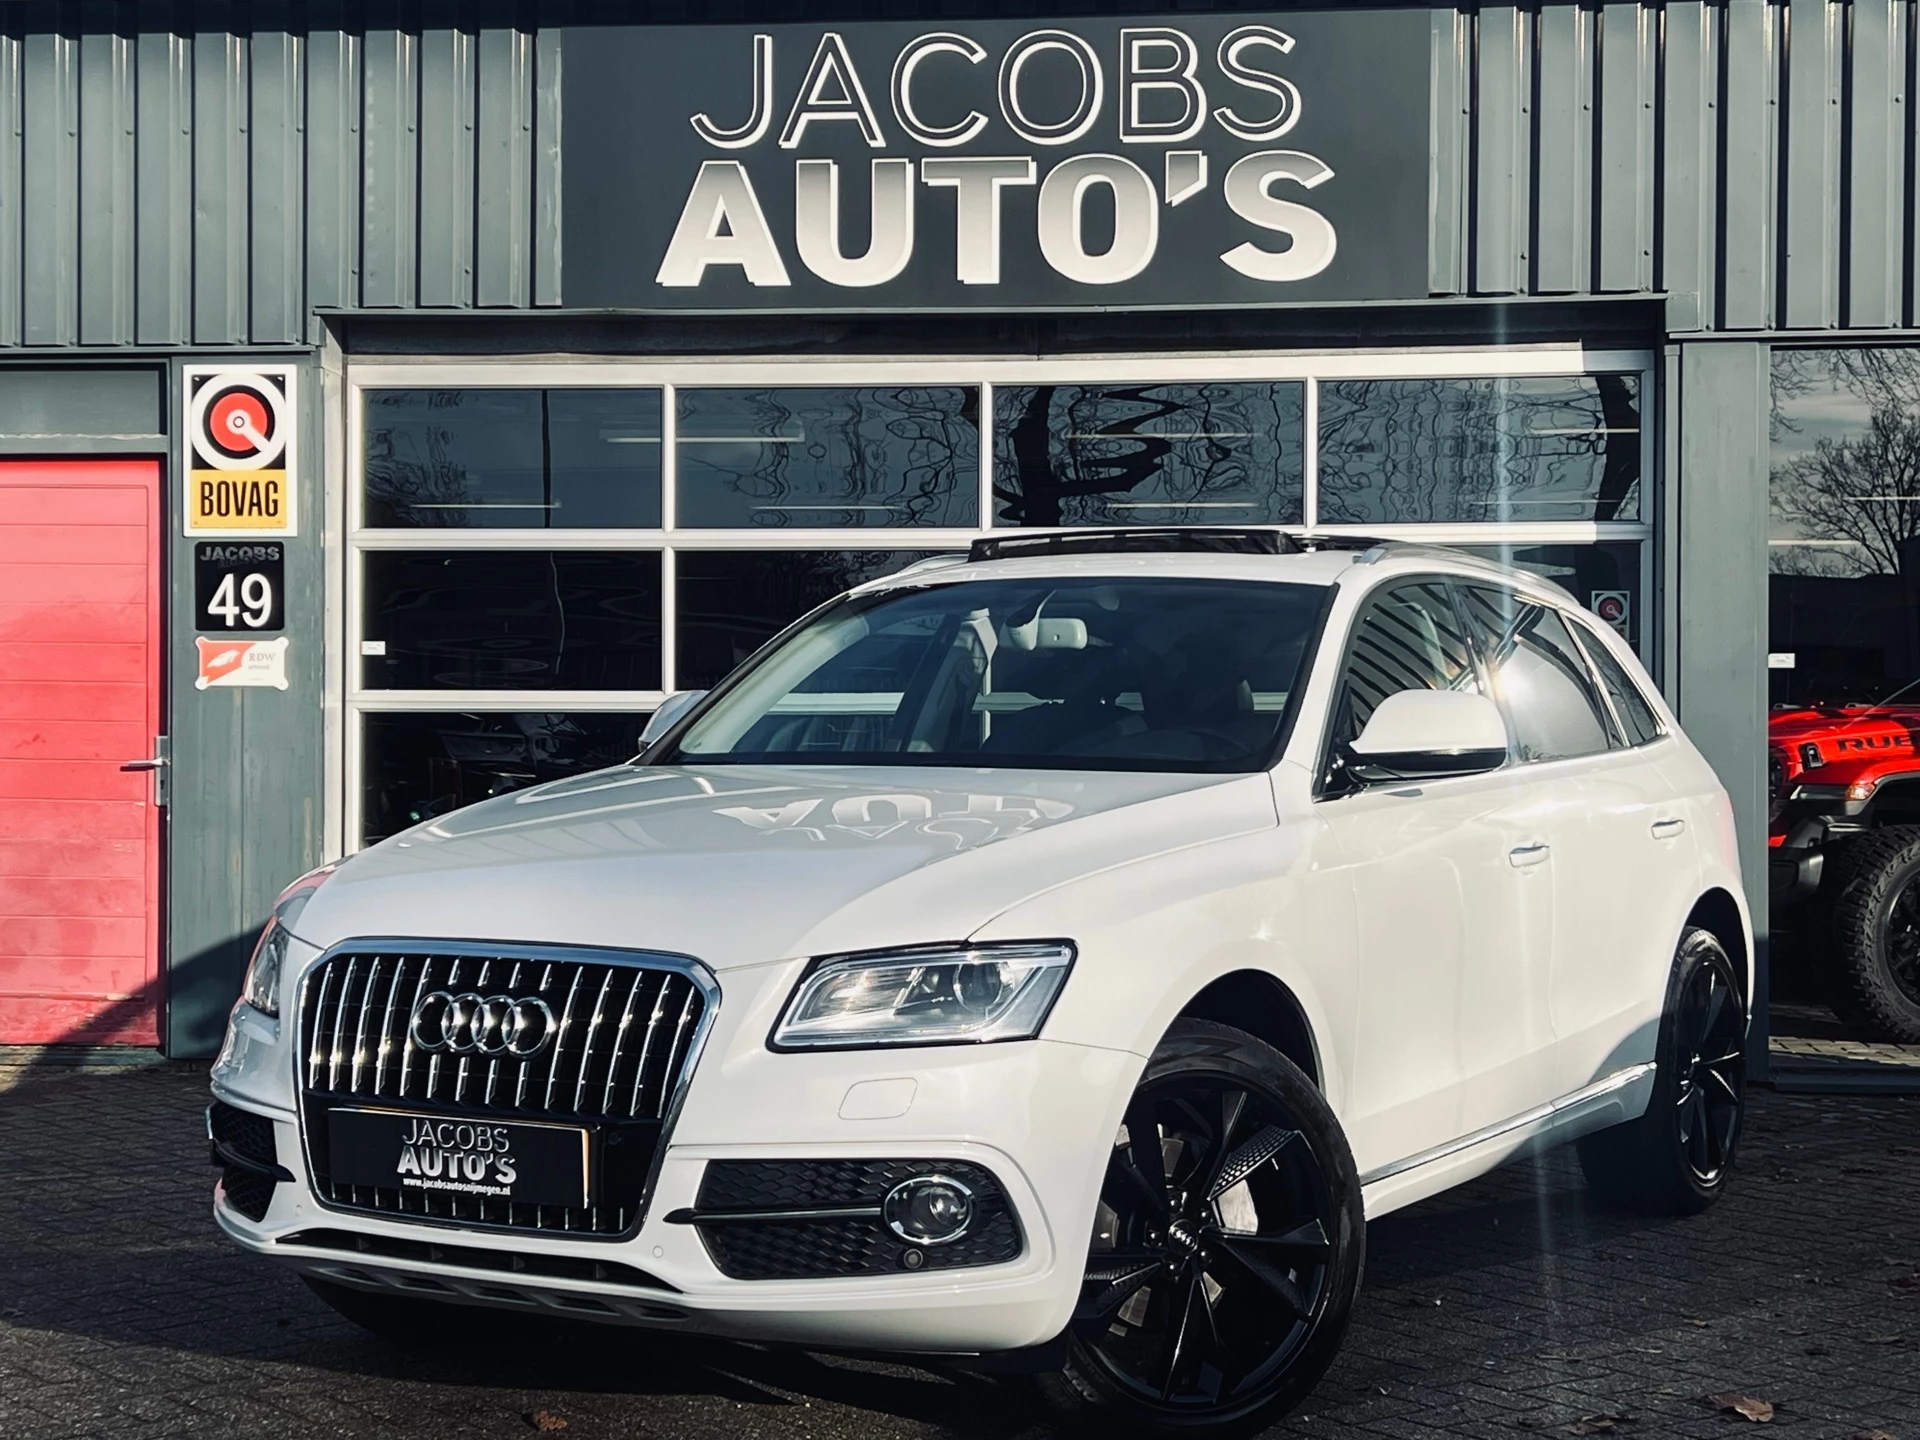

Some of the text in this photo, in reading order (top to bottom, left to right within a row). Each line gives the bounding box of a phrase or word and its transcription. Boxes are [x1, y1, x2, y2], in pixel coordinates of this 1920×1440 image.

[690, 25, 1301, 149] JACOBS
[655, 150, 1337, 287] AUTO'S
[200, 480, 279, 517] BOVAG
[199, 546, 280, 561] JACOBS
[207, 572, 272, 628] 49
[248, 652, 276, 662] RDW
[402, 1118, 510, 1153] JACOBS
[396, 1144, 517, 1184] AUTO'S
[402, 1177, 511, 1196] www.jacobsautosnijmegen.nl
